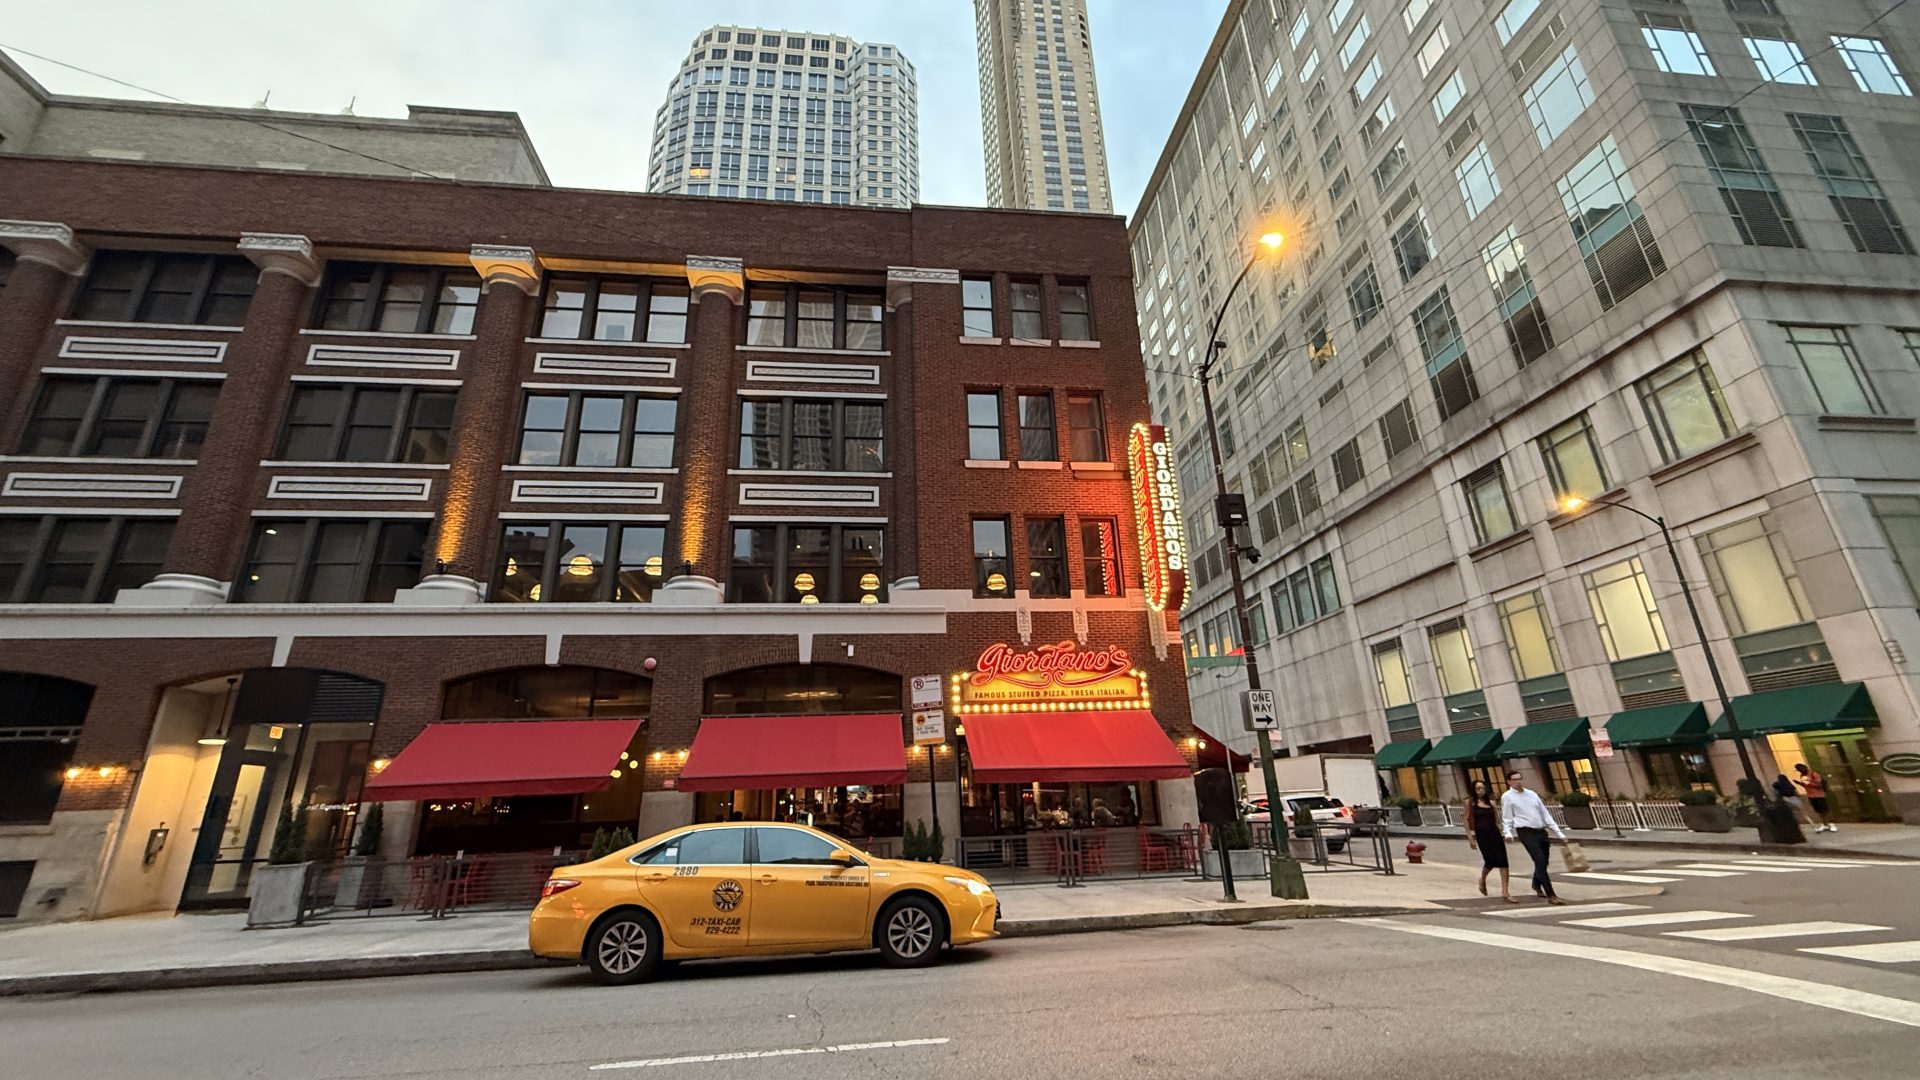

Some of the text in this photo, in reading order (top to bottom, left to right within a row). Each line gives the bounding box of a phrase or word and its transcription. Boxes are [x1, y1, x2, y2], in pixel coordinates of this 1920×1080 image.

[1152, 442, 1183, 570] GIORDANO'S
[971, 640, 1132, 688] Giordano's
[974, 691, 1006, 699] FAMOUS
[1009, 690, 1041, 698] STUFFED
[1071, 689, 1094, 697] FRESH
[1251, 693, 1271, 702] ONE
[1252, 703, 1272, 713] WAY
[673, 866, 699, 876] 2880
[690, 917, 742, 926] 312-TAXI-CAB
[705, 926, 741, 935] 829-4222
